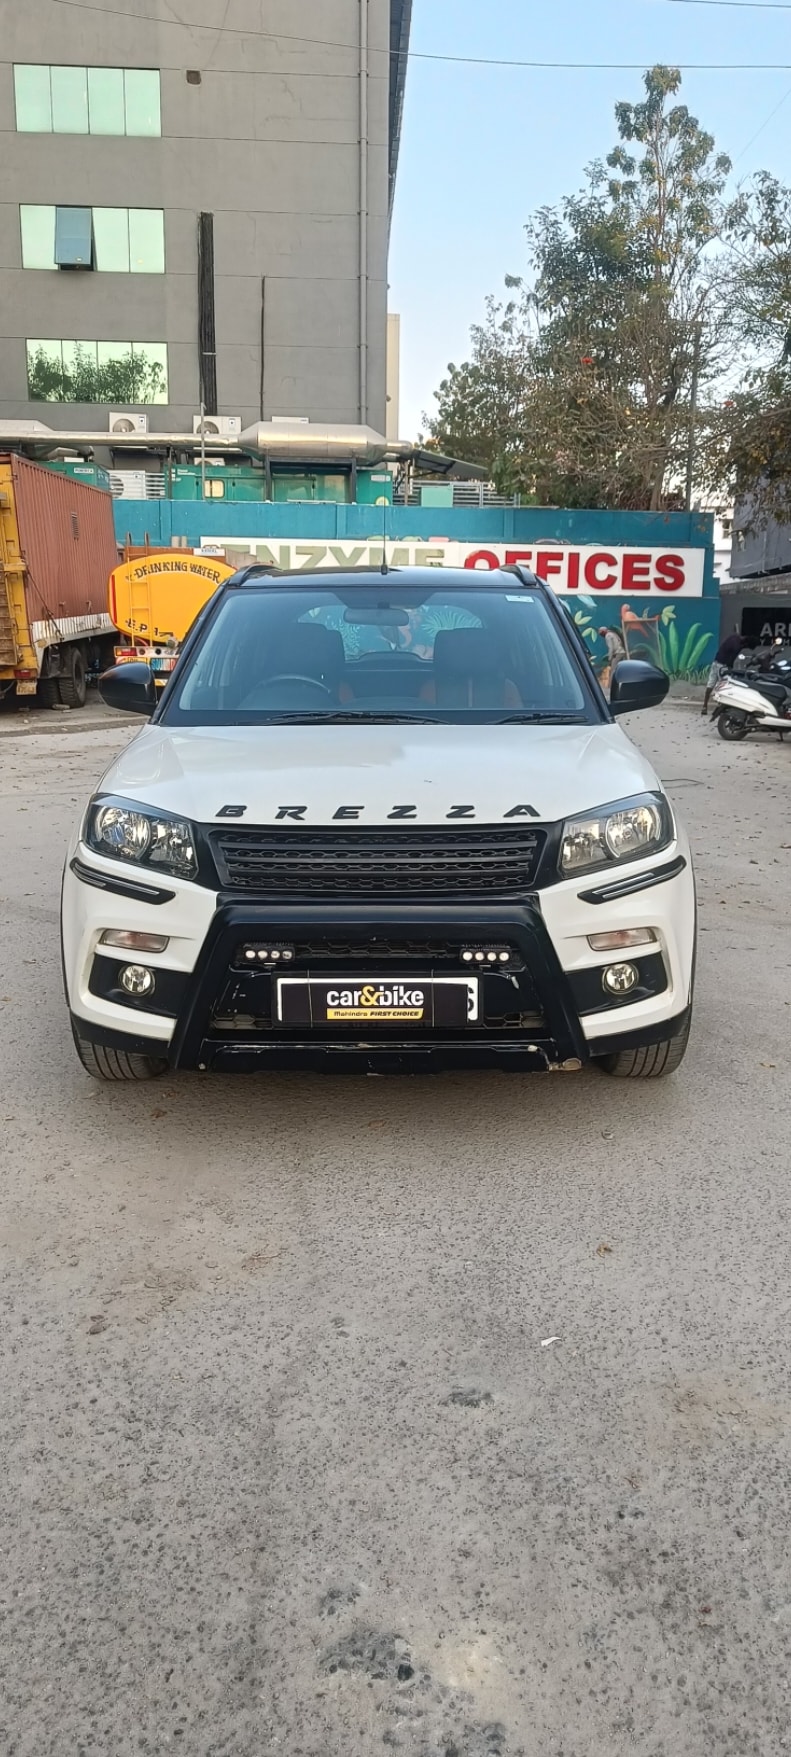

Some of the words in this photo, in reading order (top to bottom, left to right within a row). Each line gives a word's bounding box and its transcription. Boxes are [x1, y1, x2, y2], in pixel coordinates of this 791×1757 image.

[134, 561, 188, 579] DRINKING
[190, 562, 221, 584] WATER
[215, 804, 541, 821] BREZZA
[326, 985, 424, 1006] car&bike
